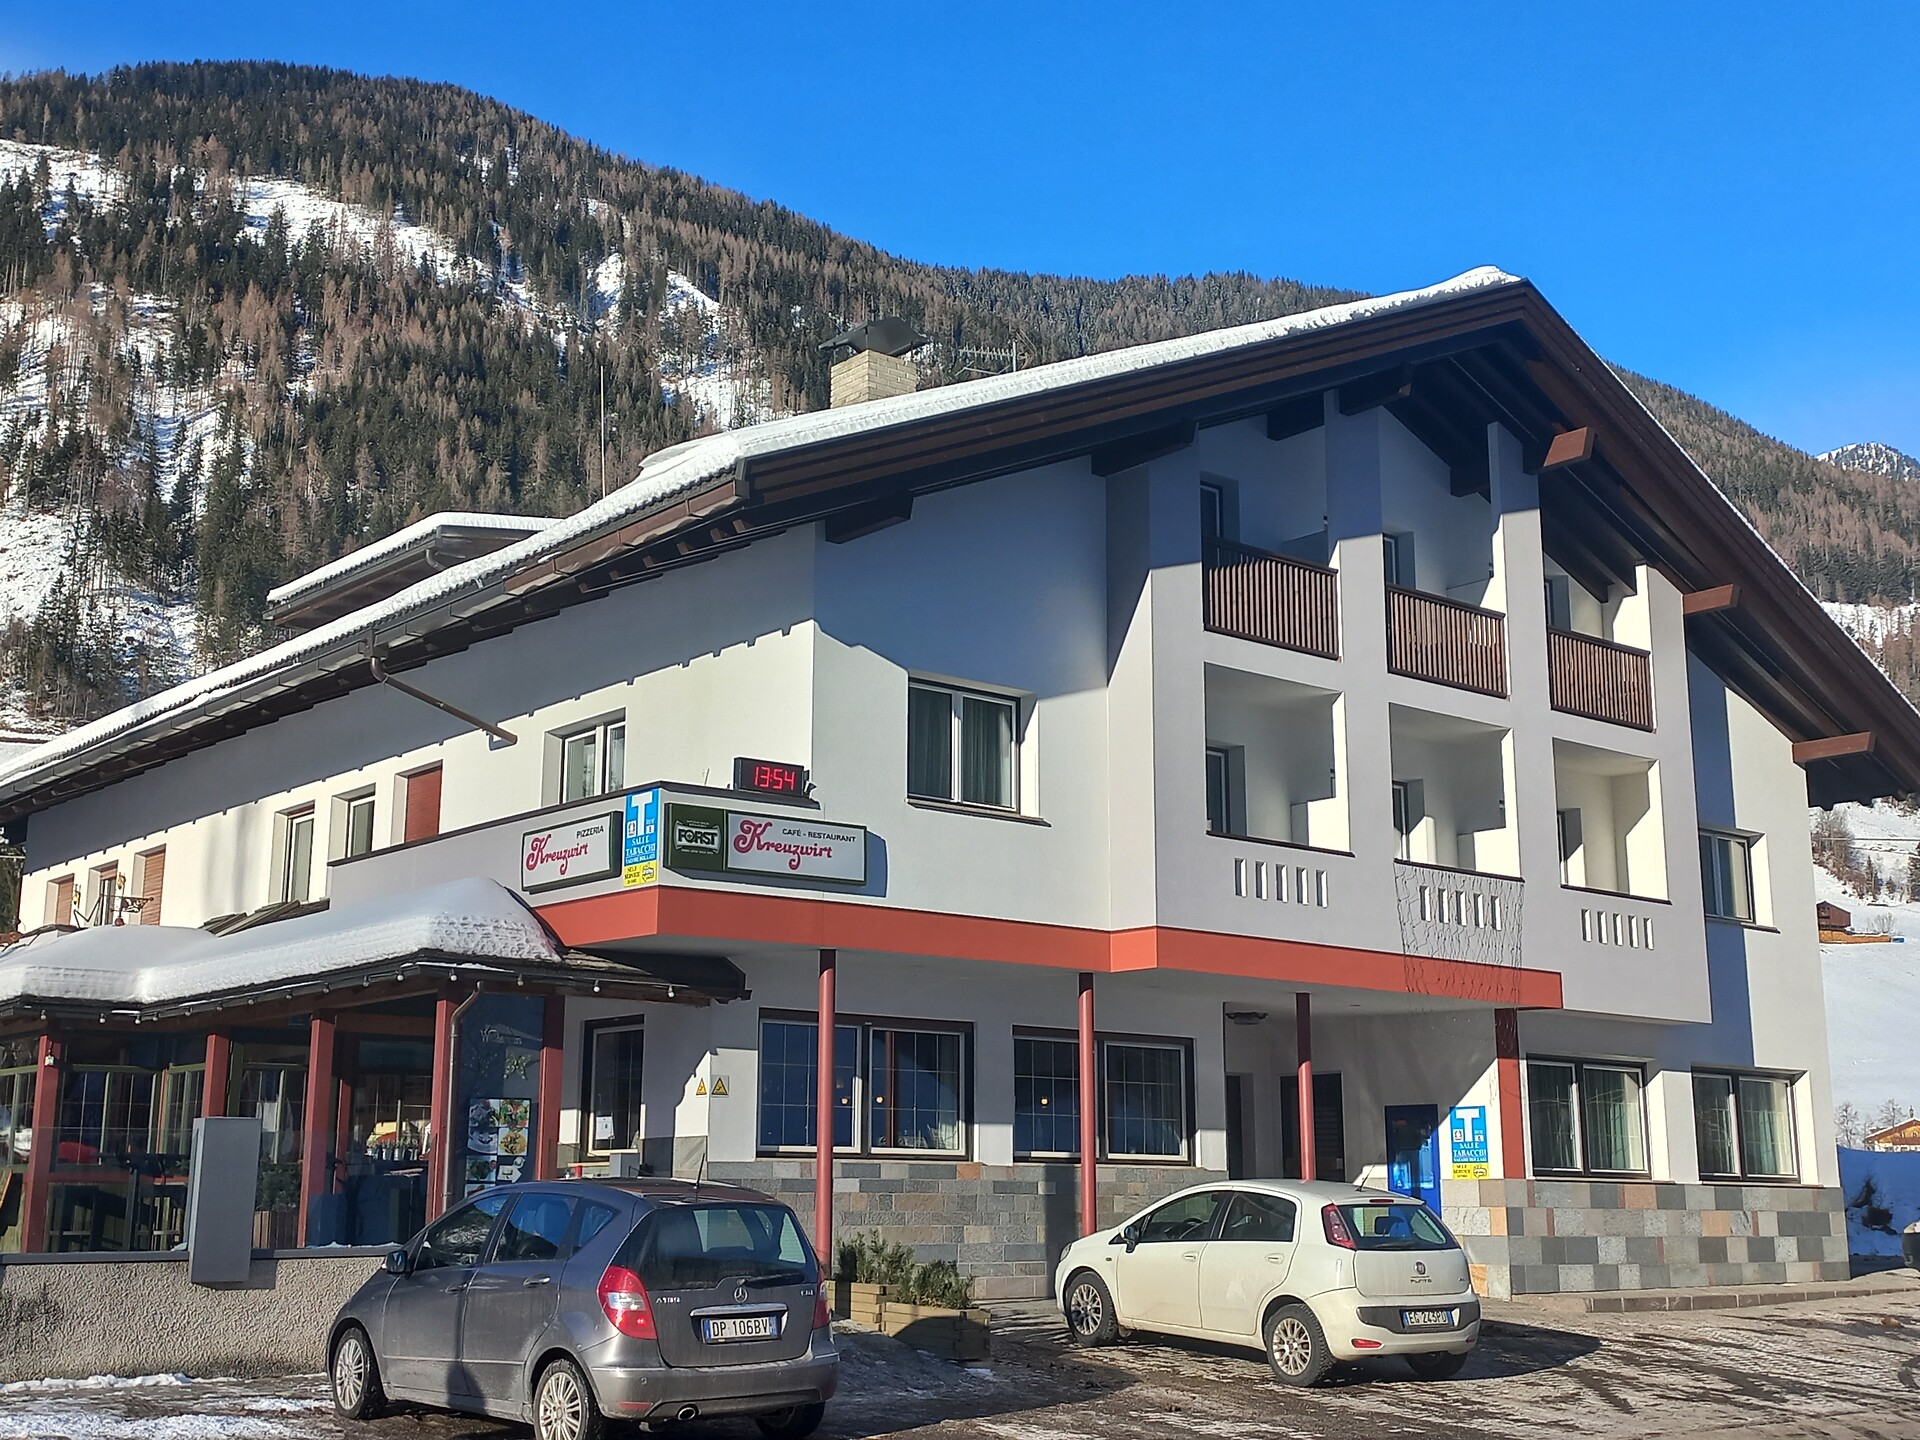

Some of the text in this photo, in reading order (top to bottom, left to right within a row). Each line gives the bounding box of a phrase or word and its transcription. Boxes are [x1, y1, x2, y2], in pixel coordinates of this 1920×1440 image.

[753, 766, 796, 791] 13:54
[630, 790, 653, 837] T
[576, 825, 604, 839] PIZZERIA
[677, 828, 718, 846] FORST
[782, 828, 801, 837] CAFÉ
[807, 832, 856, 843] RESTAURANT
[525, 833, 589, 876] Kreuzwirt
[733, 819, 833, 871] Kreuzwirt
[1455, 1108, 1480, 1142] T
[711, 1318, 768, 1337] DP 106BV
